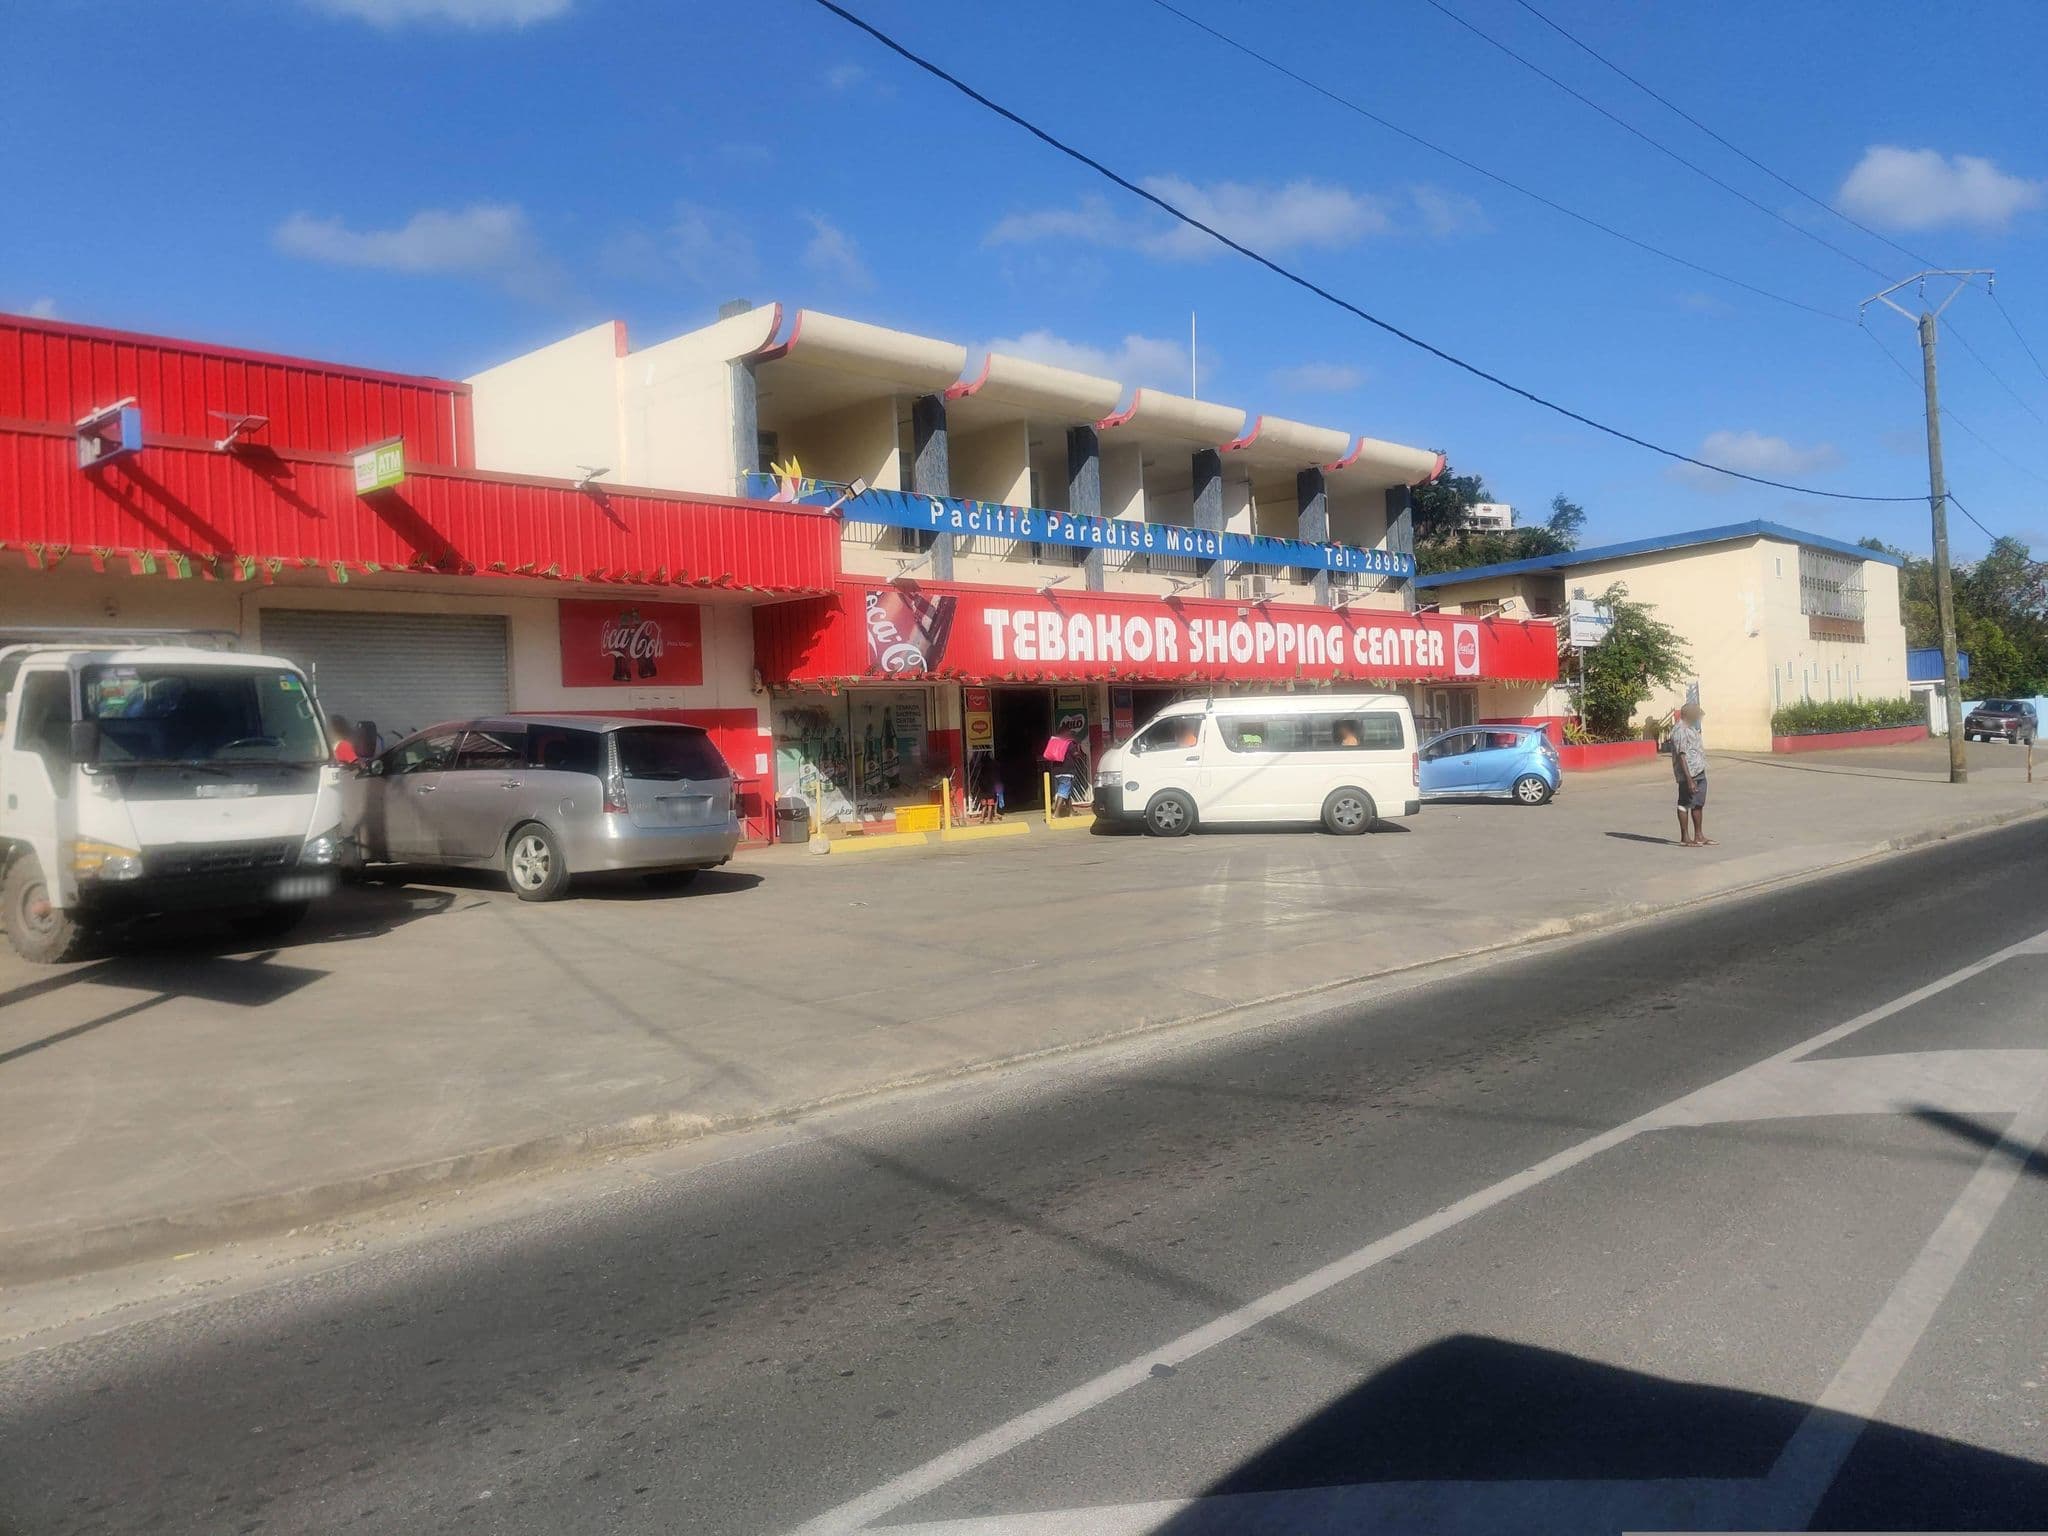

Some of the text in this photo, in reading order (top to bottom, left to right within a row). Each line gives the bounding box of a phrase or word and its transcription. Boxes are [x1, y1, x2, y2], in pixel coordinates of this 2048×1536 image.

[378, 451, 401, 473] ATM
[930, 501, 1223, 555] Pacific Paradise Motel
[1324, 548, 1357, 567] Tel:
[984, 608, 1444, 666] TEBAKOR SHOPPING CENTER
[1062, 719, 1084, 730] MILO
